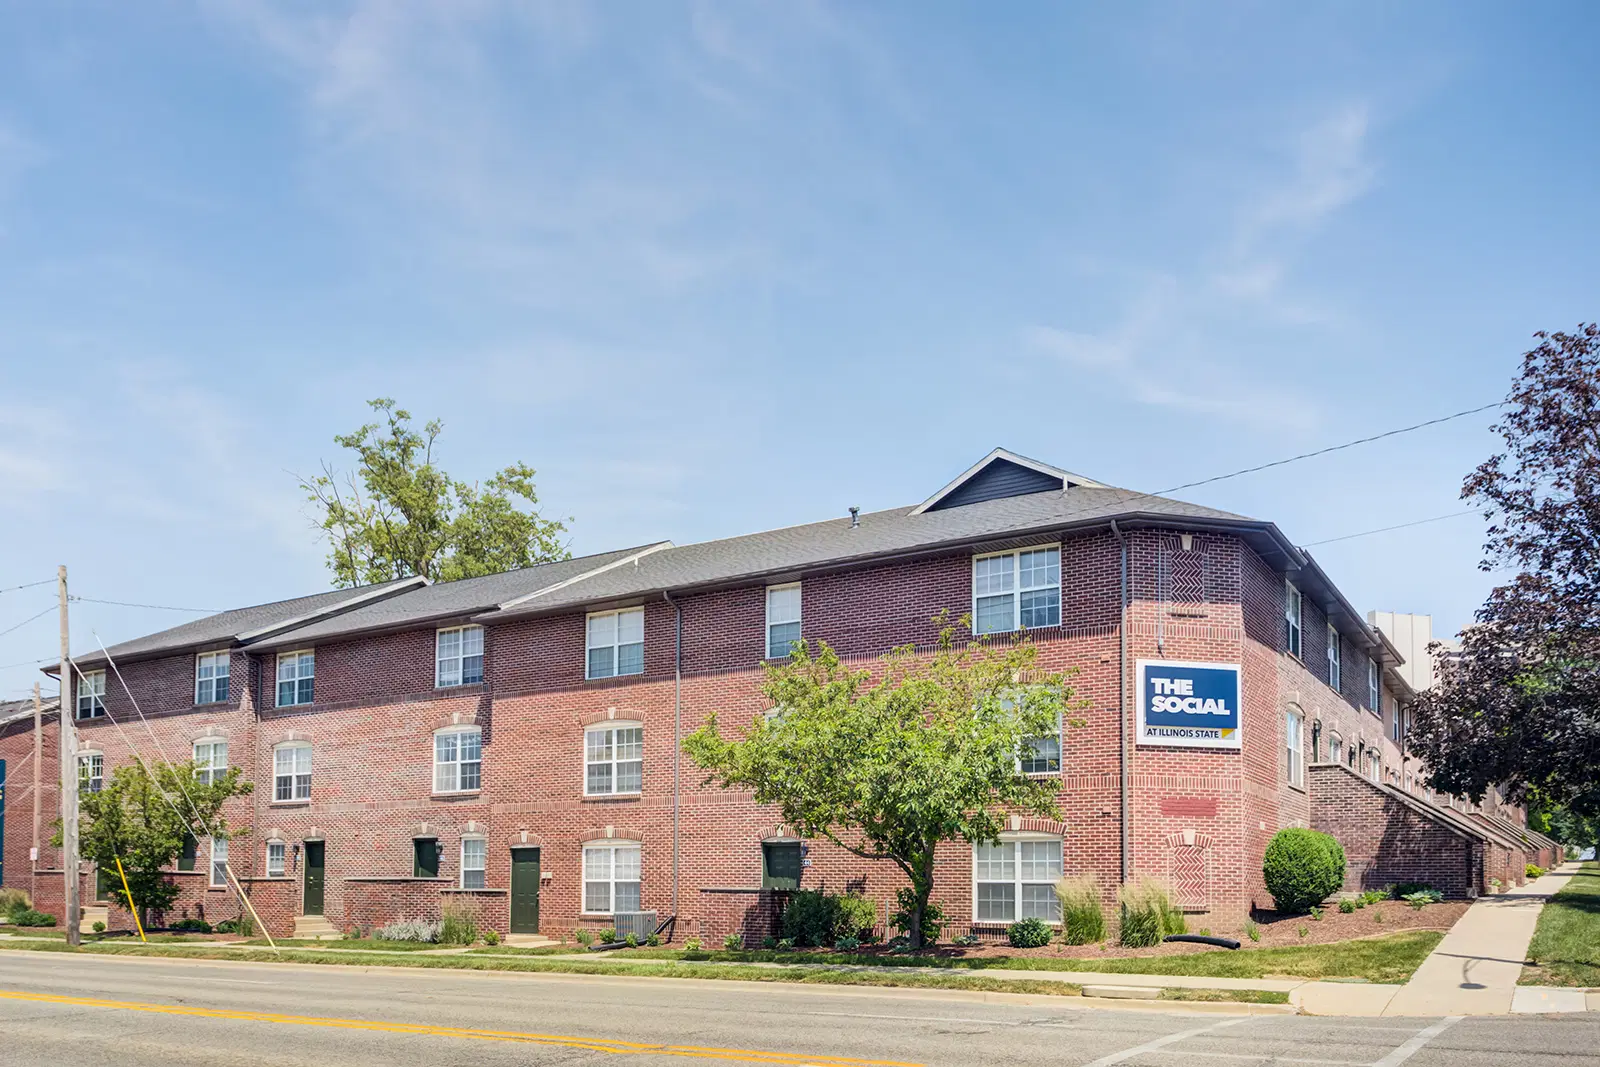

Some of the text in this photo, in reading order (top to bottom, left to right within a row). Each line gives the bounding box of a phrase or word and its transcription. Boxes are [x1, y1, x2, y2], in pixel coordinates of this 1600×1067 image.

[1151, 678, 1193, 695] THE
[1151, 696, 1230, 715] SOCIAL
[1147, 728, 1219, 738] AT ILLINOIS STATE
